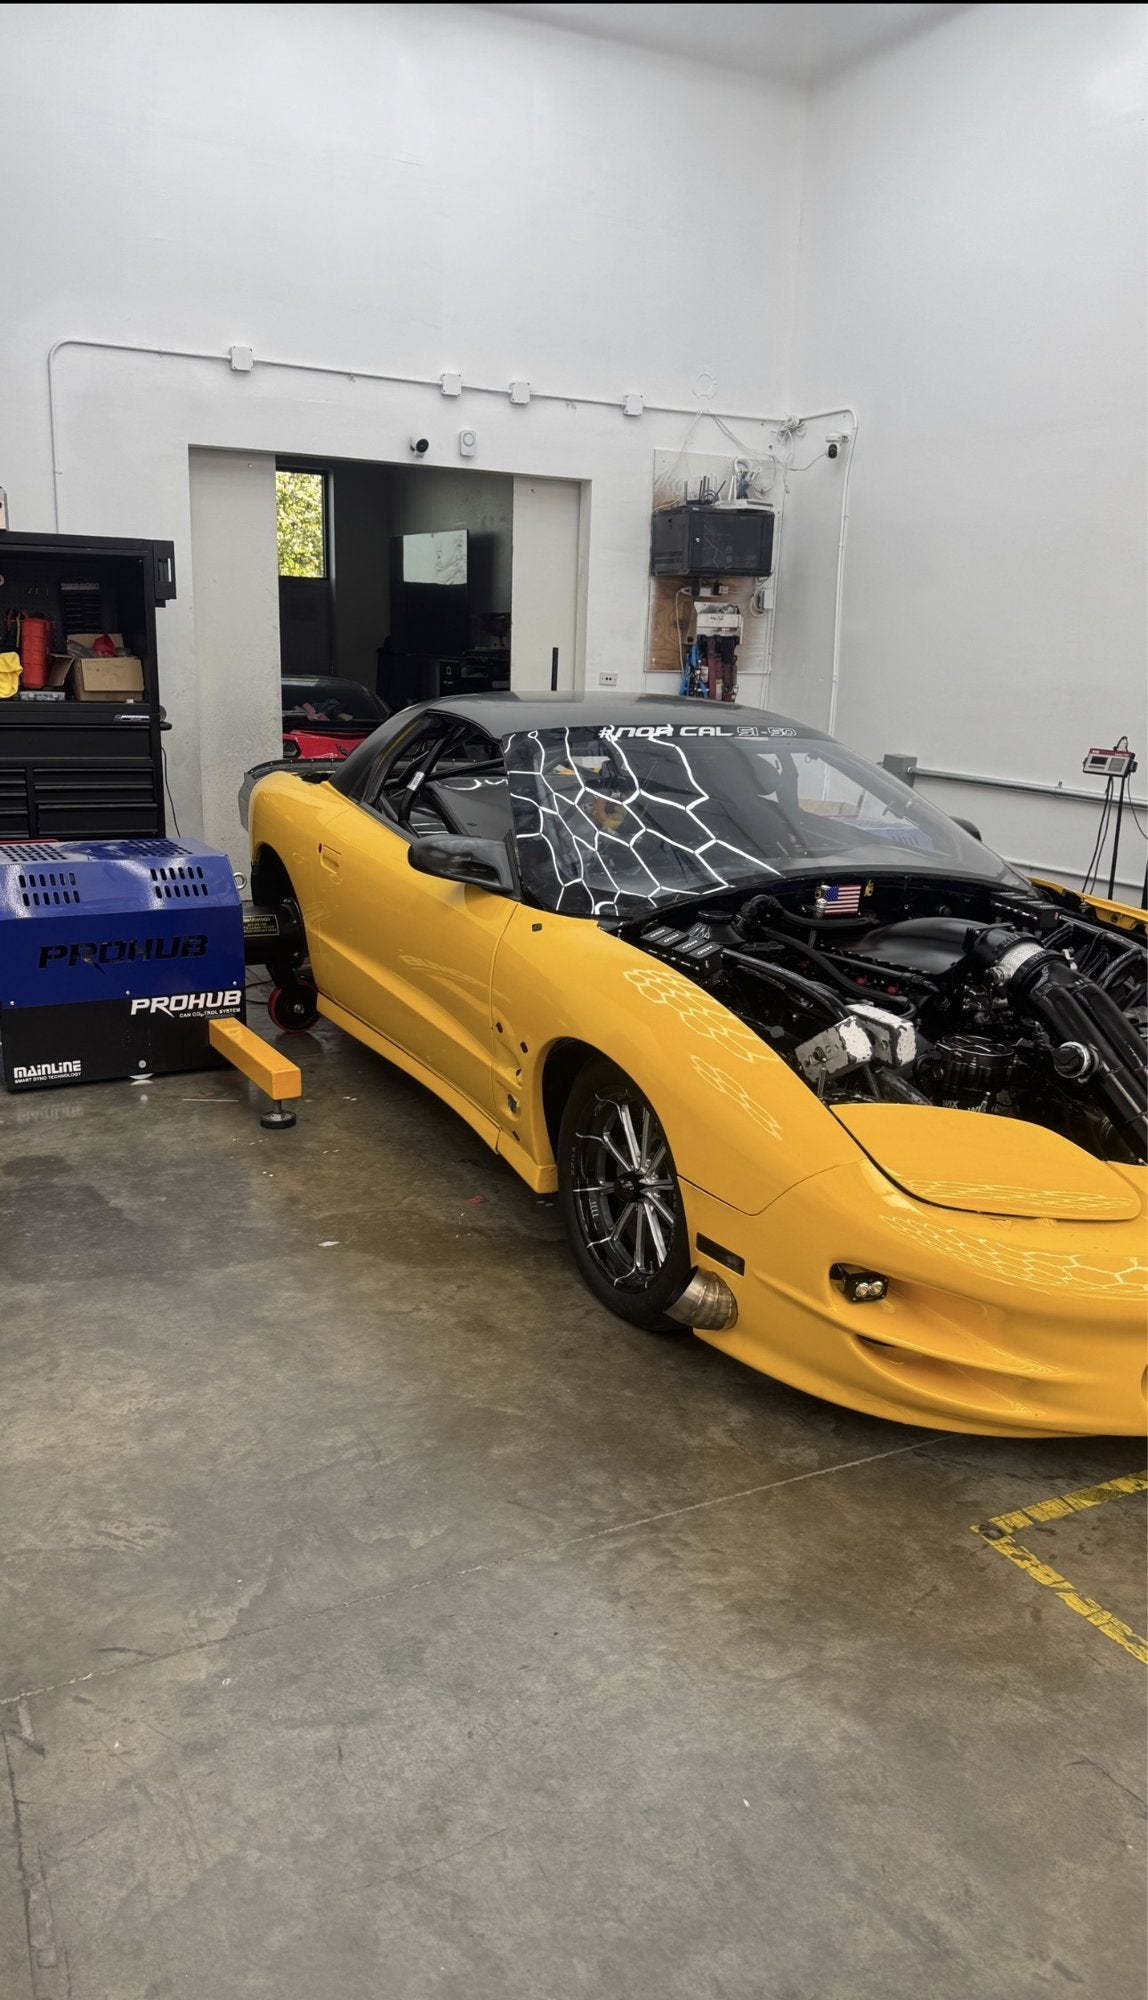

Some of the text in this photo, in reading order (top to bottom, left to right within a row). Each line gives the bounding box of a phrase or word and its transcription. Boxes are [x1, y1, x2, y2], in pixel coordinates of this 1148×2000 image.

[679, 726, 734, 737] CAL
[38, 935, 208, 975] PROHUB
[130, 990, 242, 1019] PROHUB
[48, 1072, 81, 1080] TECHNOLOGY
